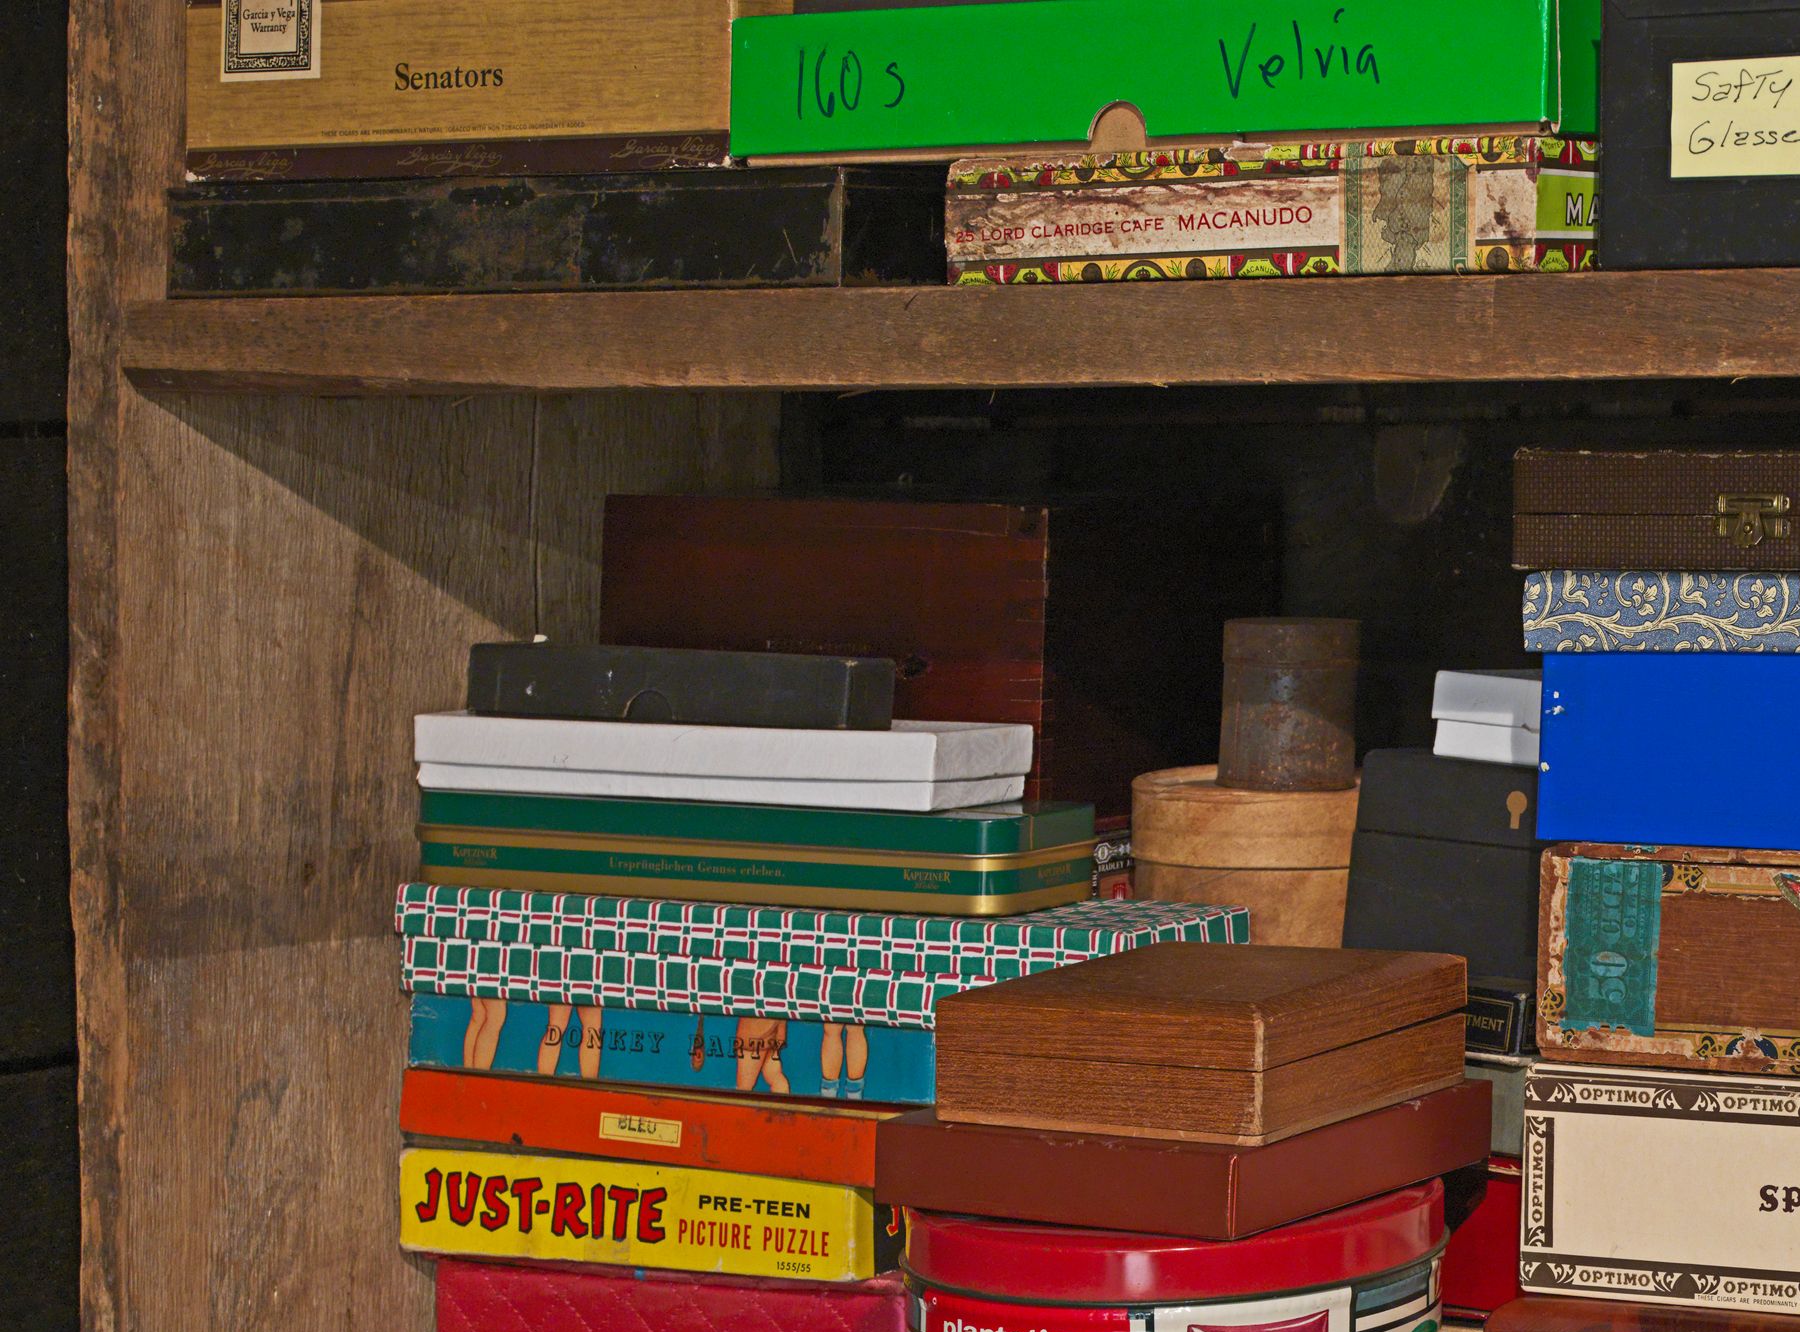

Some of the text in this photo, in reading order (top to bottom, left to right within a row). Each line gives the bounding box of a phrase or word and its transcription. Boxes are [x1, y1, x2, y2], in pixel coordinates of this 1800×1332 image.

[242, 8, 296, 21] Garcia y Vega
[250, 22, 288, 33] Warranty
[1220, 9, 1380, 99] Velvia
[393, 61, 505, 93] Senators
[955, 205, 1314, 244] 25 LORD CLARIDGE CAFE MACANUDO
[697, 861, 737, 876] Genuss
[544, 1023, 787, 1061] DONKEY PARTY
[1579, 1088, 1651, 1106] OPTIMO
[1722, 1096, 1798, 1114] OPTIMO
[1529, 1142, 1545, 1224] OPTIMO
[415, 1167, 811, 1243] JUST-RITE PRE-TEEN
[678, 1218, 830, 1258] PICTURE PUZZLE
[776, 1261, 812, 1274] 1555/55
[1579, 1268, 1651, 1288] OPTIMO
[1722, 1280, 1797, 1298] OPTIMO
[1697, 1294, 1714, 1302] THESE
[1716, 1296, 1738, 1304] CIGARS
[1739, 1297, 1750, 1305] ARE
[1753, 1298, 1798, 1308] PREDOMINANTLY
